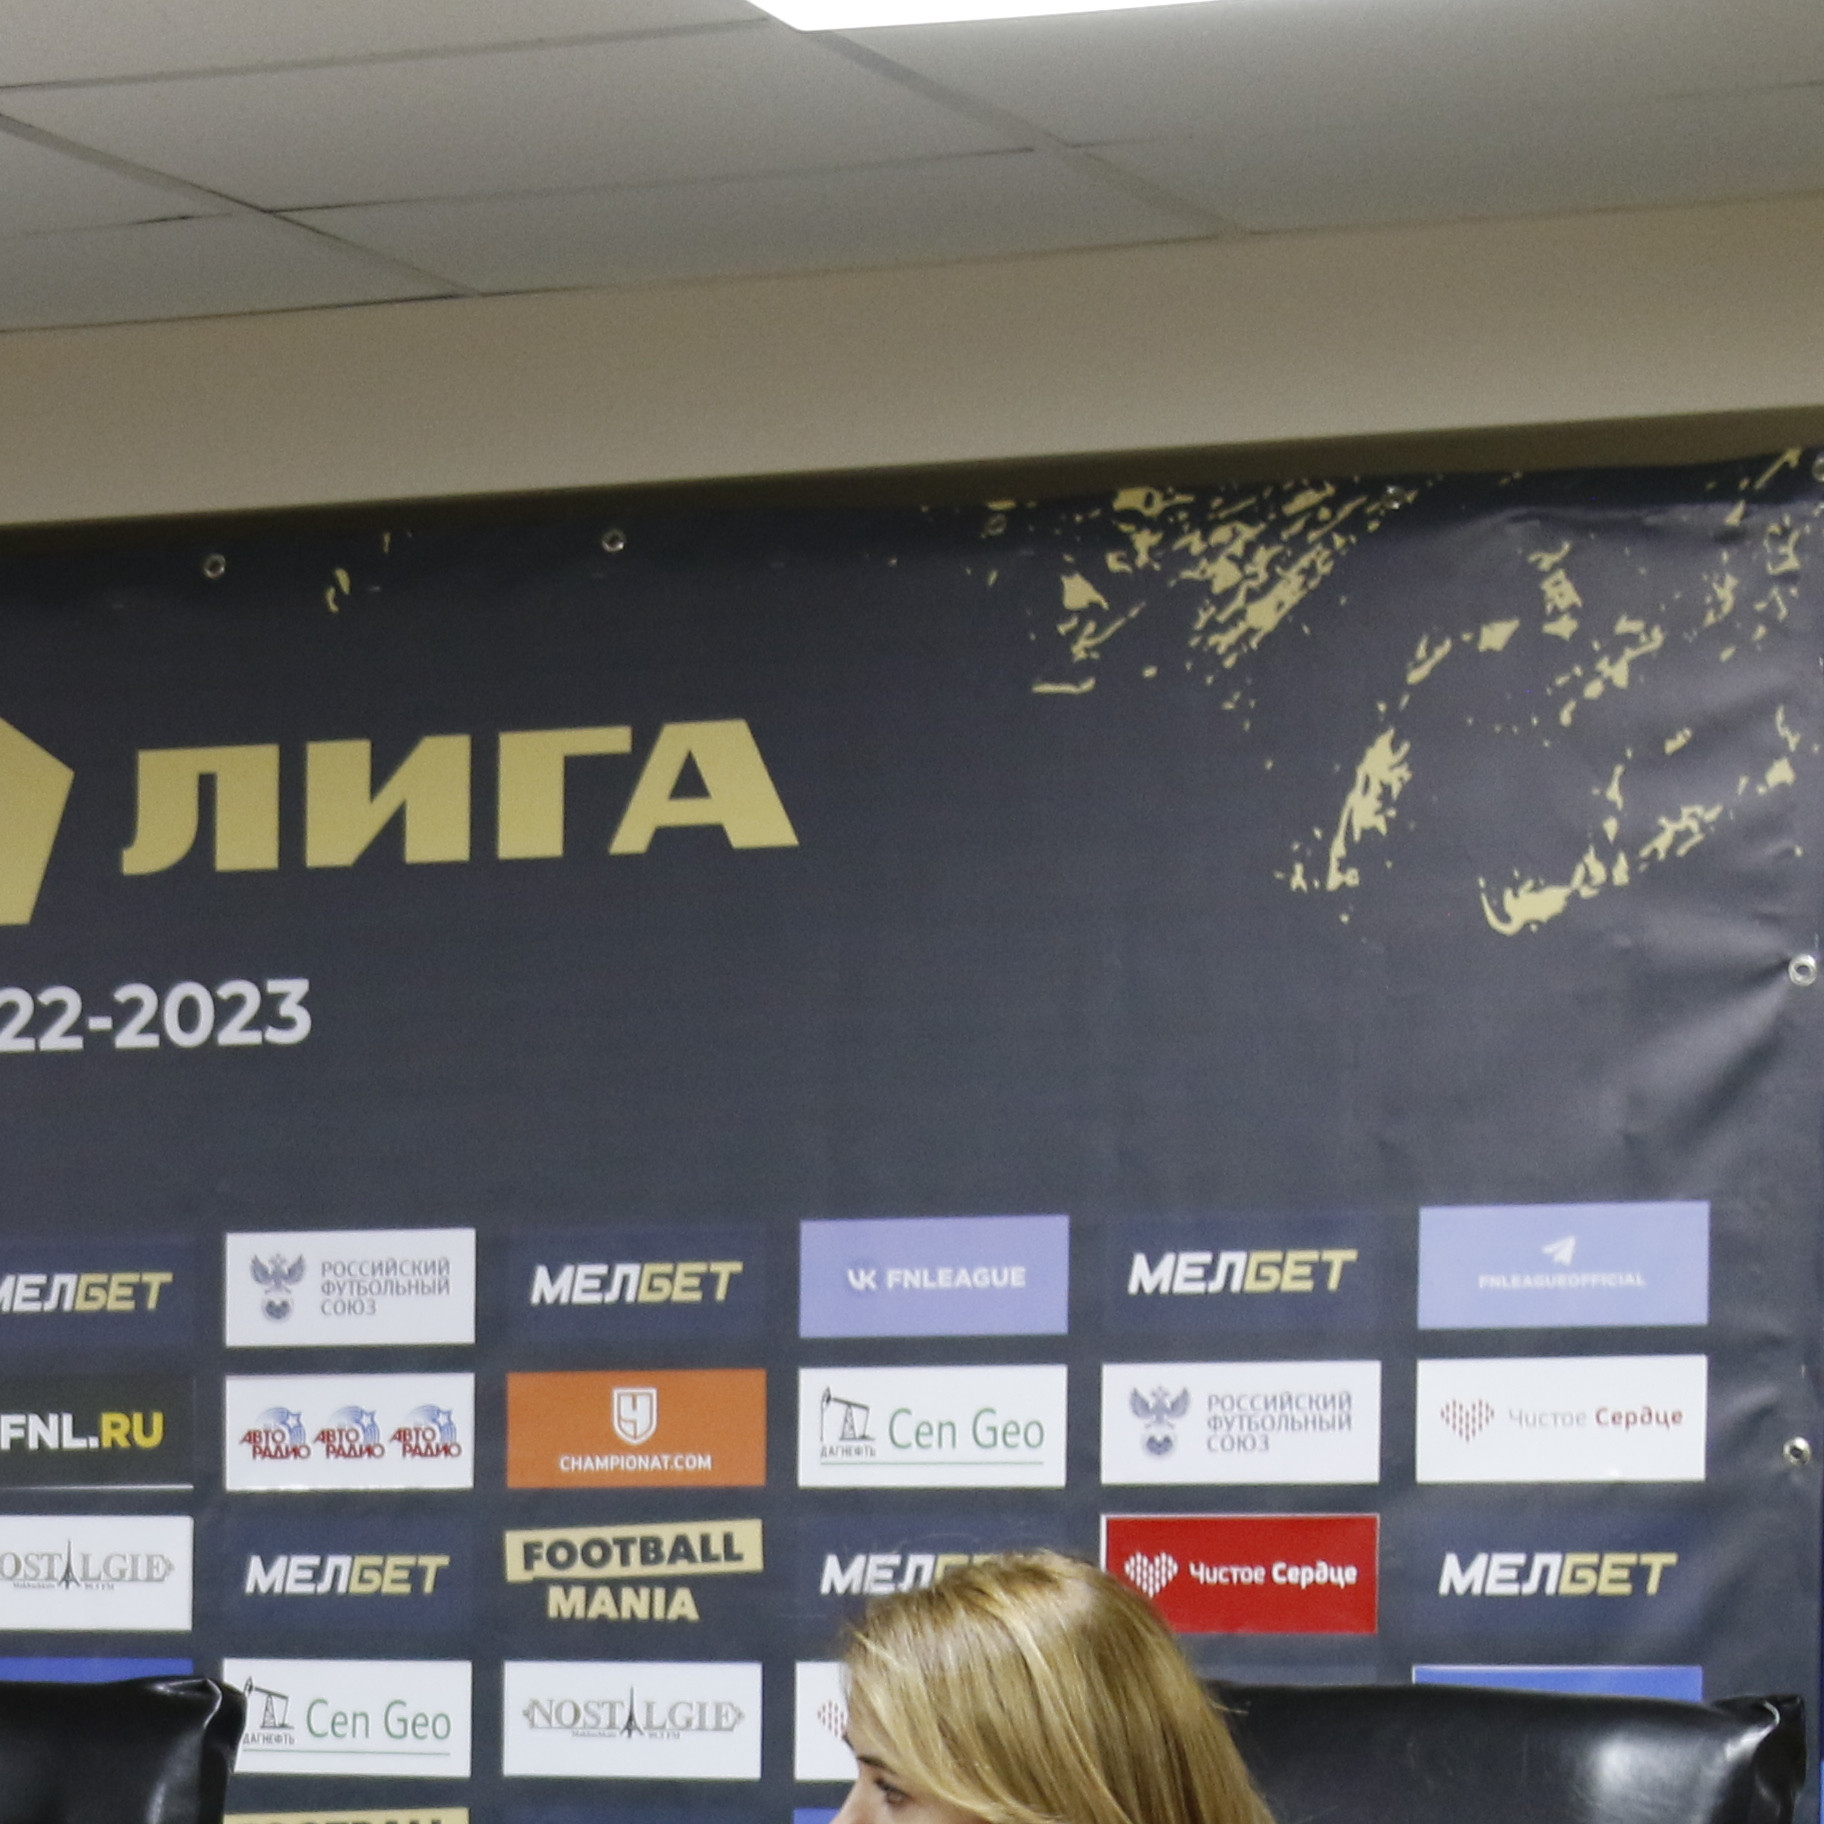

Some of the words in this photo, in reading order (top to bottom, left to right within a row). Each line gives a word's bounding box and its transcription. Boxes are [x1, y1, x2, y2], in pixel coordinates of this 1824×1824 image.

[121, 719, 799, 876] ЛИГА
[320, 1257, 451, 1278] РОССИЙСКИЙ
[1128, 1249, 1357, 1295] МЕЛБЕТ
[320, 1277, 451, 1298] ФУТБОЛЬНЫЙ
[531, 1261, 743, 1305] МЕЛБЕТ
[887, 1267, 1026, 1290] FNLEAGUE
[320, 1299, 376, 1317] СОЮЗ
[1208, 1391, 1352, 1412] РОССИЙСКИЙ
[1207, 1413, 1352, 1433] ФУТБОЛЬНЫЙ
[1595, 1407, 1683, 1429] Сердце
[239, 1429, 286, 1444] АВТО
[313, 1428, 359, 1443] АВТО
[389, 1427, 436, 1443] АВТО
[889, 1409, 957, 1449] Cen
[973, 1408, 1045, 1450] Geo
[252, 1444, 311, 1460] РАДИО
[326, 1443, 385, 1459] РАДИО
[402, 1443, 462, 1459] РАДИО
[1207, 1435, 1269, 1453] СОЮЗ
[560, 1454, 711, 1472] CHAMPIONAT.COM
[522, 1532, 744, 1572] FOOTBALL
[245, 1555, 450, 1596] МЕЛБЕТ
[821, 1553, 992, 1595] МЕЛ
[1189, 1562, 1265, 1584] Чистое
[1272, 1562, 1357, 1588] Сердце
[1439, 1551, 1677, 1597] МЕЛБЕТ
[549, 1586, 699, 1621] MANIA
[306, 1700, 371, 1739] Cen
[384, 1700, 451, 1740] Geo
